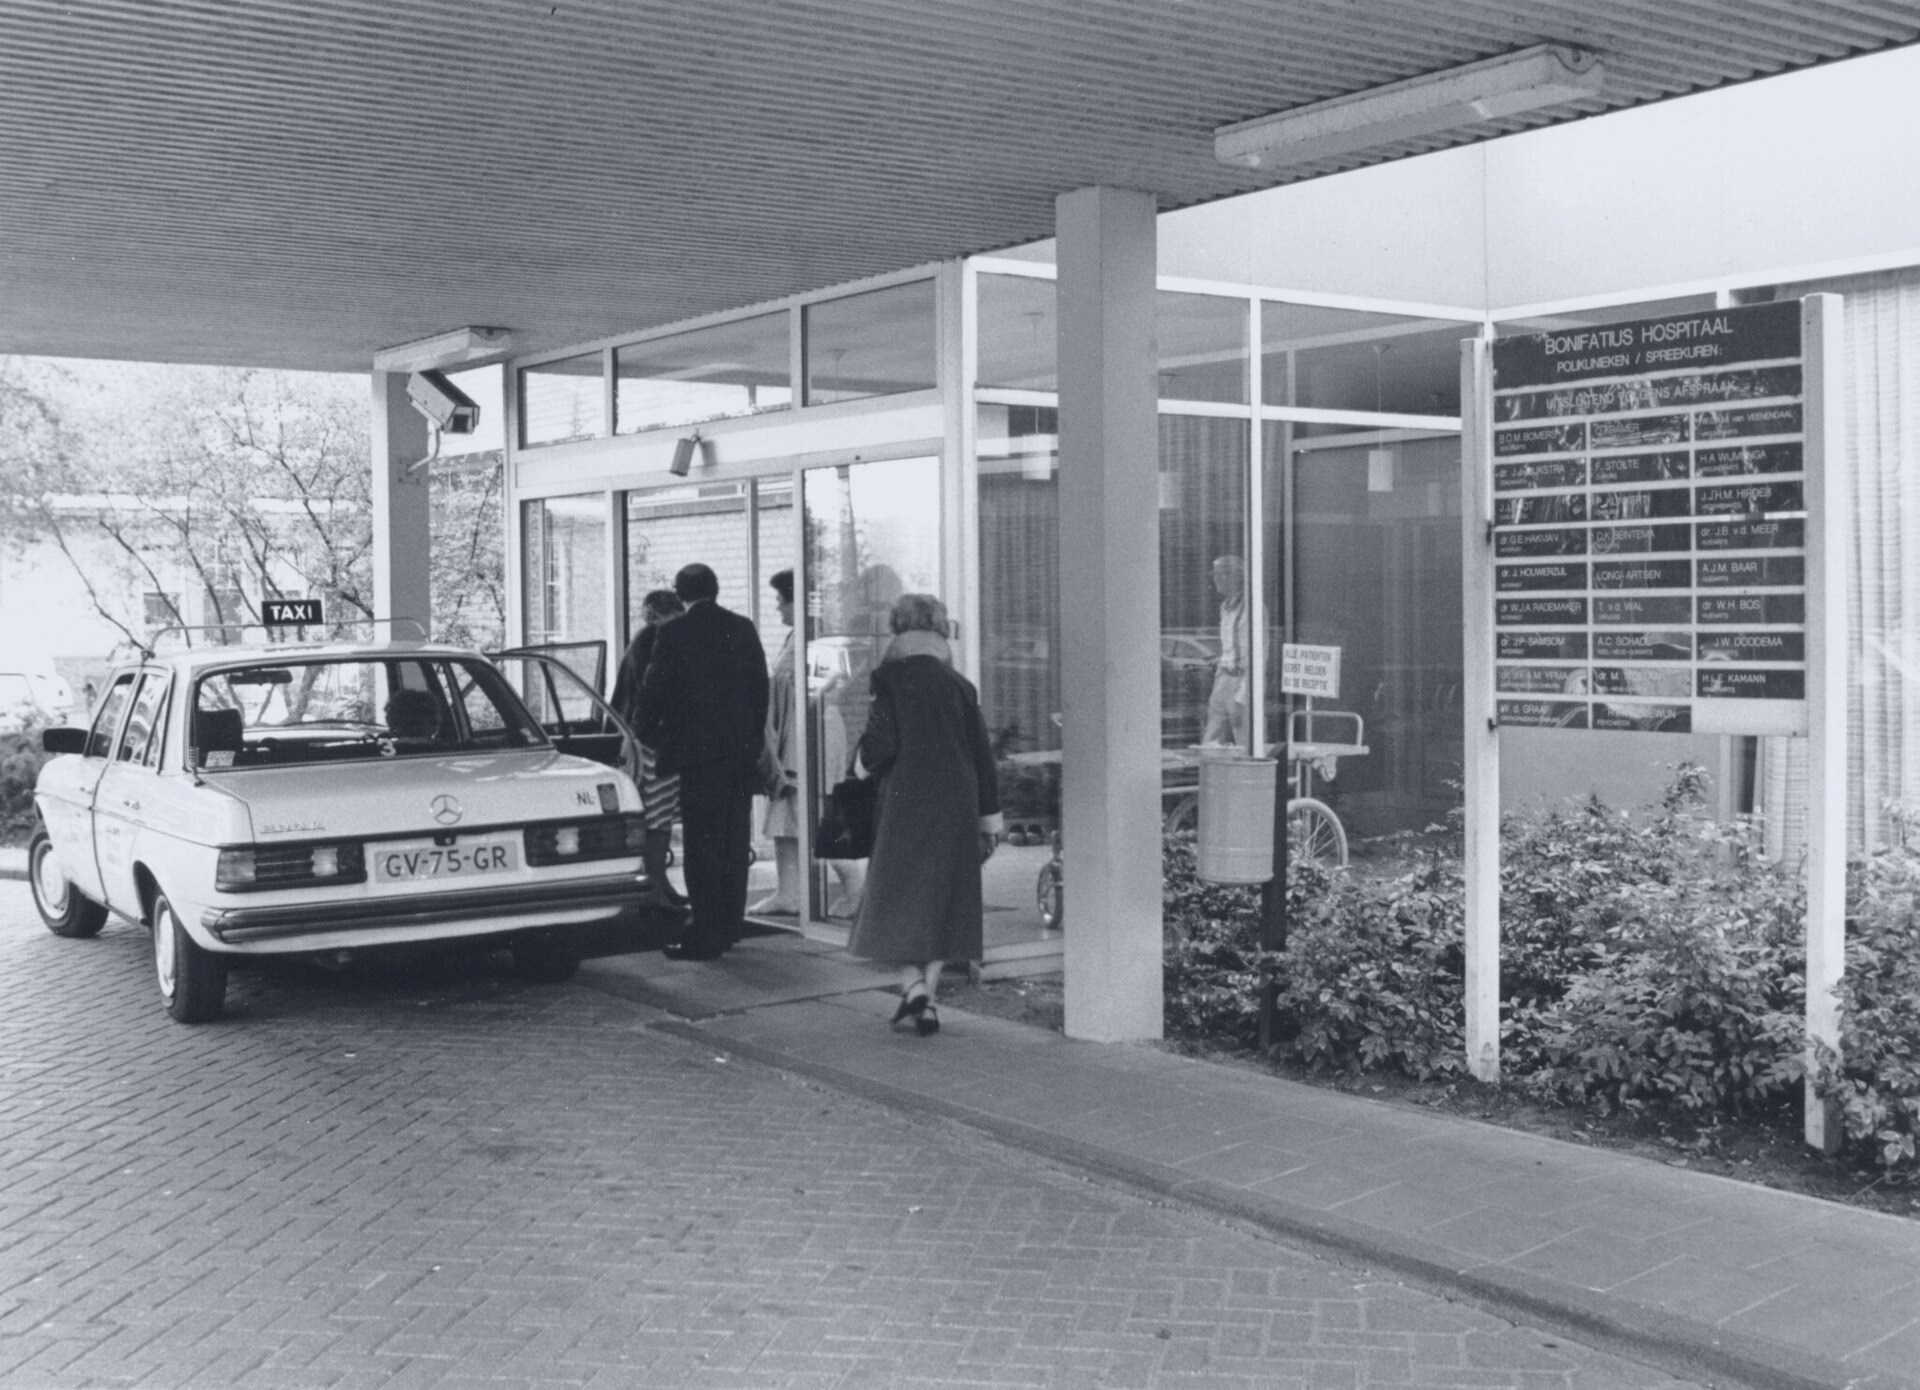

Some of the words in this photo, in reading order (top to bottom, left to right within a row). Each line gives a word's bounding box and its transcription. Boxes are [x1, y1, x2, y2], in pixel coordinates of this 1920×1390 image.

[1545, 328, 1634, 355] BONIFATIUS
[1641, 316, 1734, 344] HOSPITAAL
[1604, 458, 1640, 471] STOLTE
[1750, 523, 1779, 535] MEER
[1731, 561, 1758, 573] BAAR
[1624, 601, 1644, 612] WAL
[1739, 599, 1761, 610] BOS
[270, 604, 313, 621] TAXI
[1727, 673, 1767, 684] KAMANN
[377, 738, 397, 757] 3
[576, 791, 595, 806] NL
[385, 845, 508, 879] GV-75-GR
